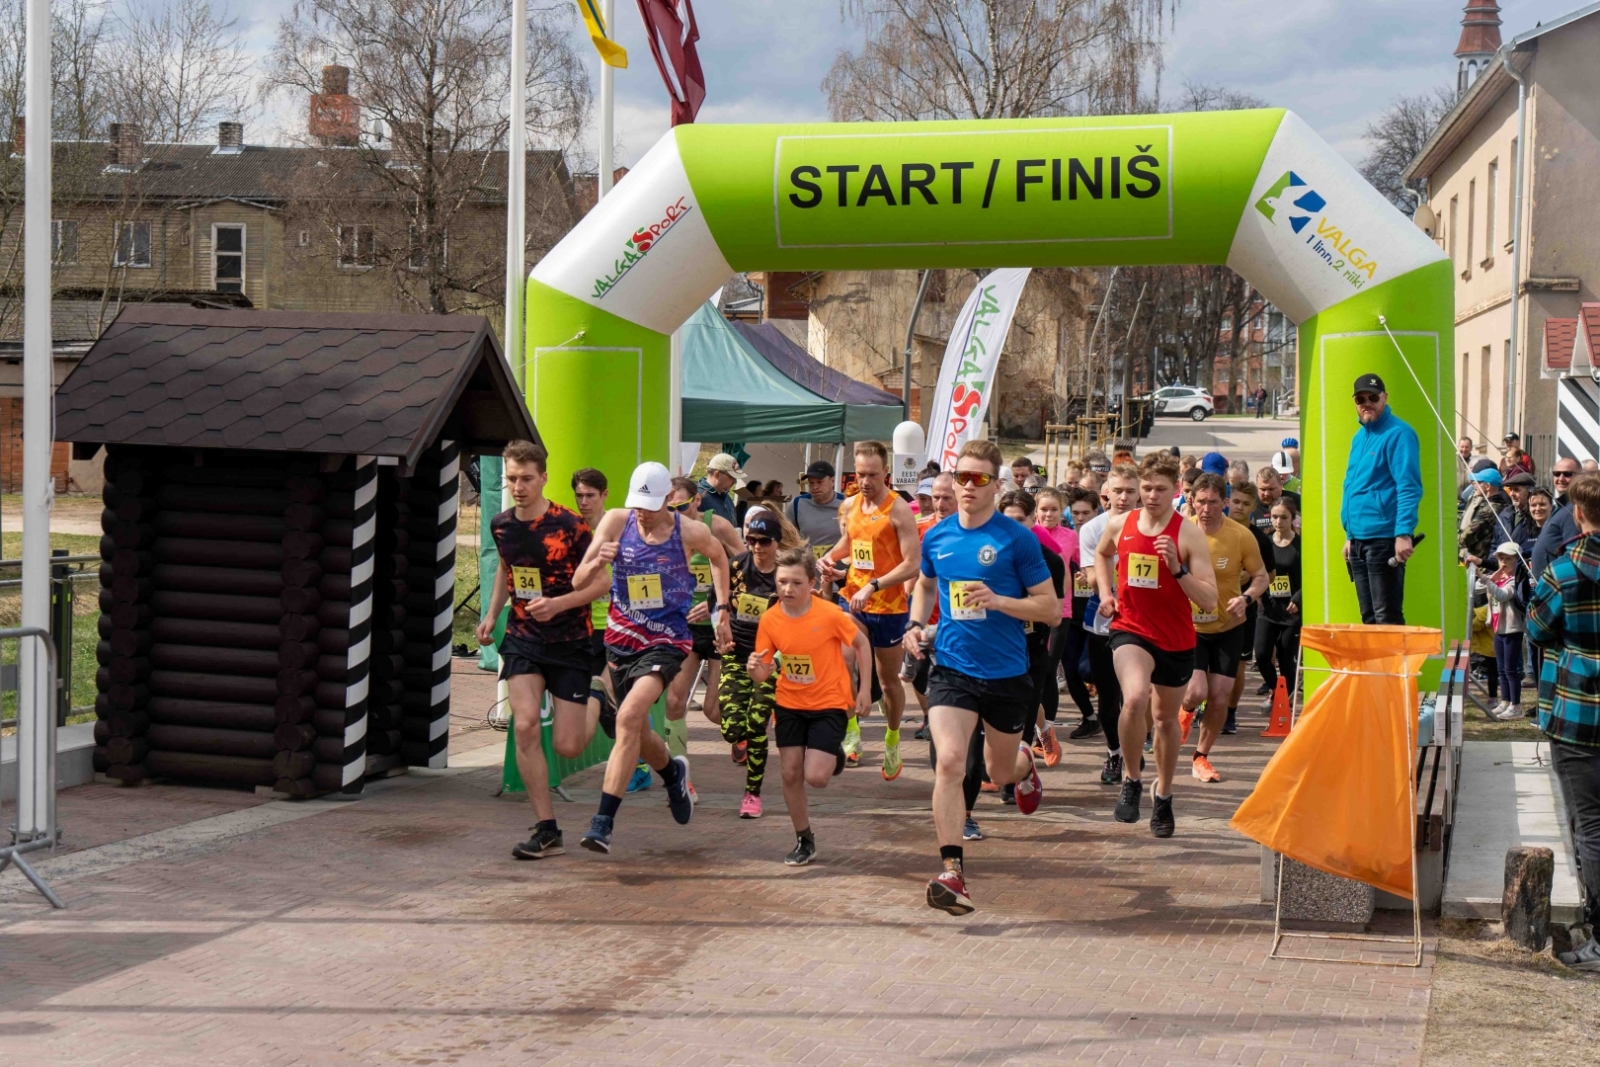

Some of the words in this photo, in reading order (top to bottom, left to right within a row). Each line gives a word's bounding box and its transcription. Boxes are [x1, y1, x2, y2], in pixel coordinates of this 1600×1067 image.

[787, 162, 975, 209] START
[981, 158, 1001, 208] /
[1015, 144, 1162, 203] FINIŠ
[1317, 217, 1377, 279] VALGA
[1306, 234, 1315, 244] 1
[1343, 270, 1365, 289] riiki
[853, 548, 871, 561] 101
[1135, 563, 1152, 577] 17
[519, 576, 535, 590] 34
[1271, 581, 1289, 592] 109
[641, 584, 649, 598] 1
[744, 603, 760, 616] 26
[785, 662, 811, 676] 127
